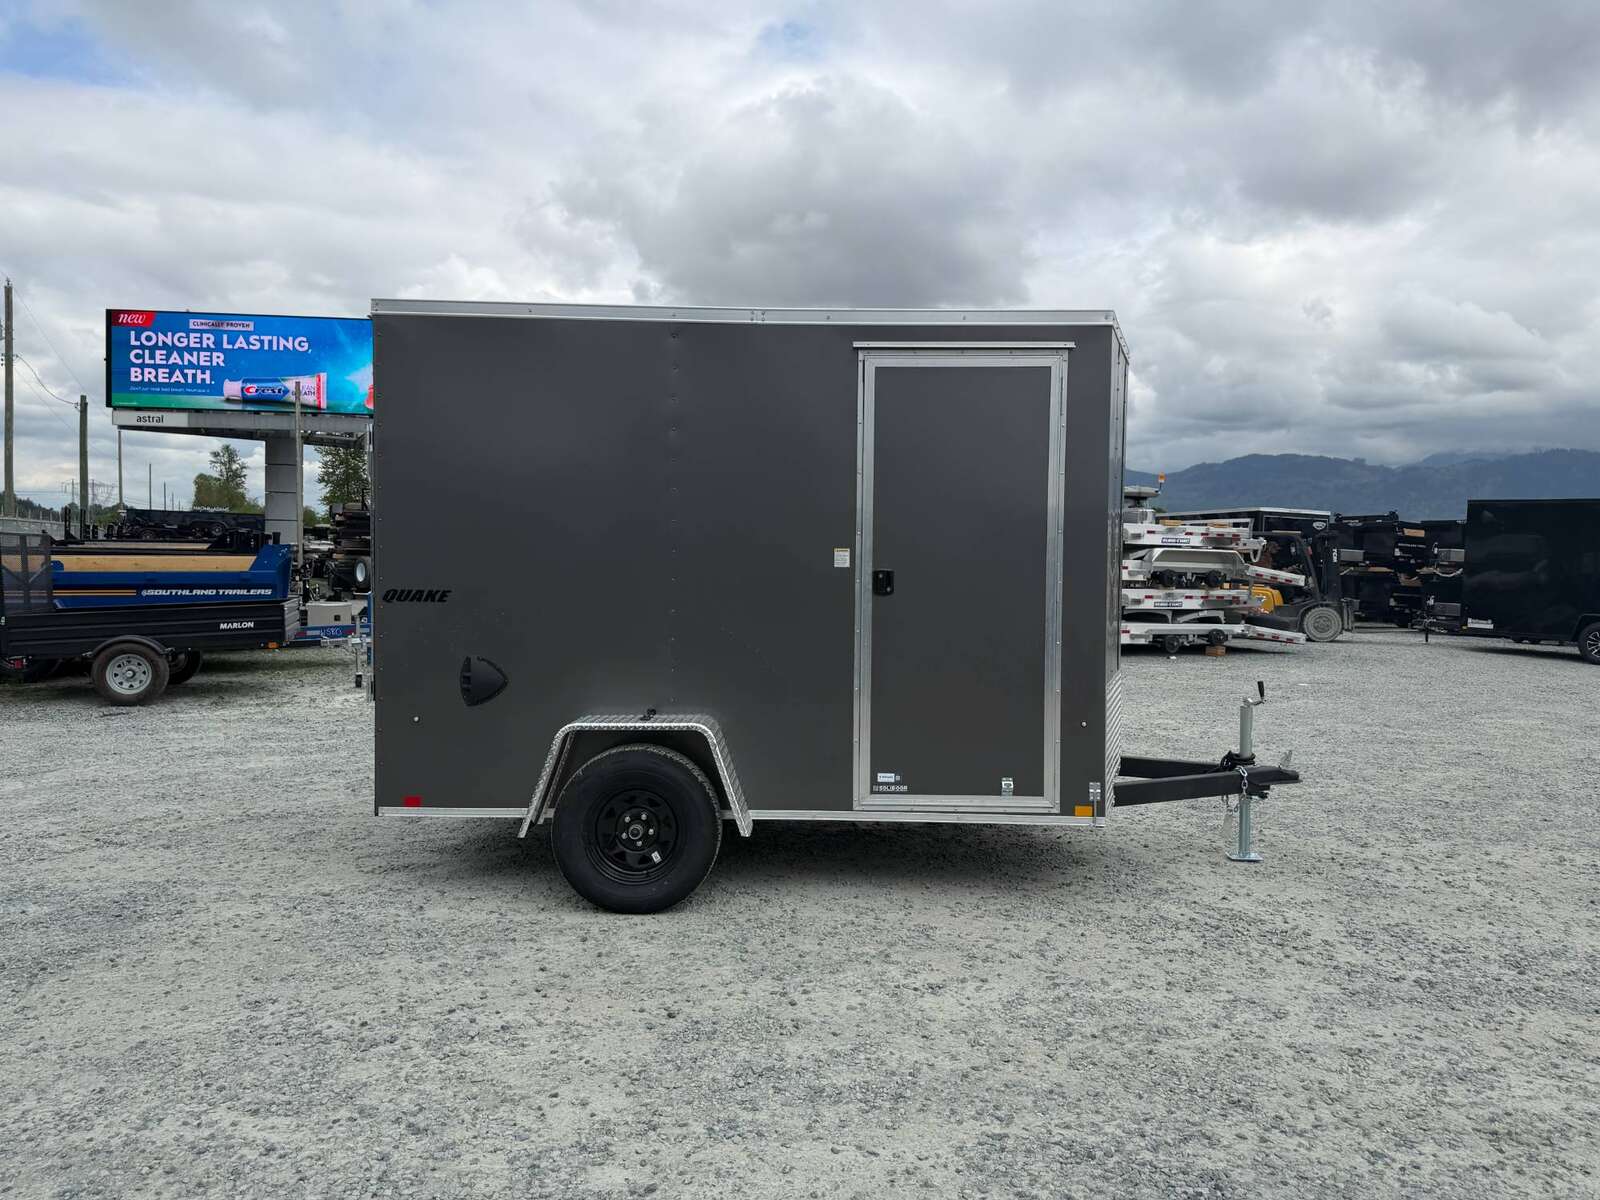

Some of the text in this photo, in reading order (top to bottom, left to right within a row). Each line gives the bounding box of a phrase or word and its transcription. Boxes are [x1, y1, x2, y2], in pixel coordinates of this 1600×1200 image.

[118, 313, 146, 324] new
[192, 320, 225, 328] CLINICALLY
[129, 330, 312, 354] LONGER LASTING,
[129, 348, 225, 367] CLEANER
[129, 367, 215, 385] BREATH.
[136, 415, 164, 424] astral
[382, 588, 452, 602] QUAKE
[219, 622, 254, 630] MARLON
